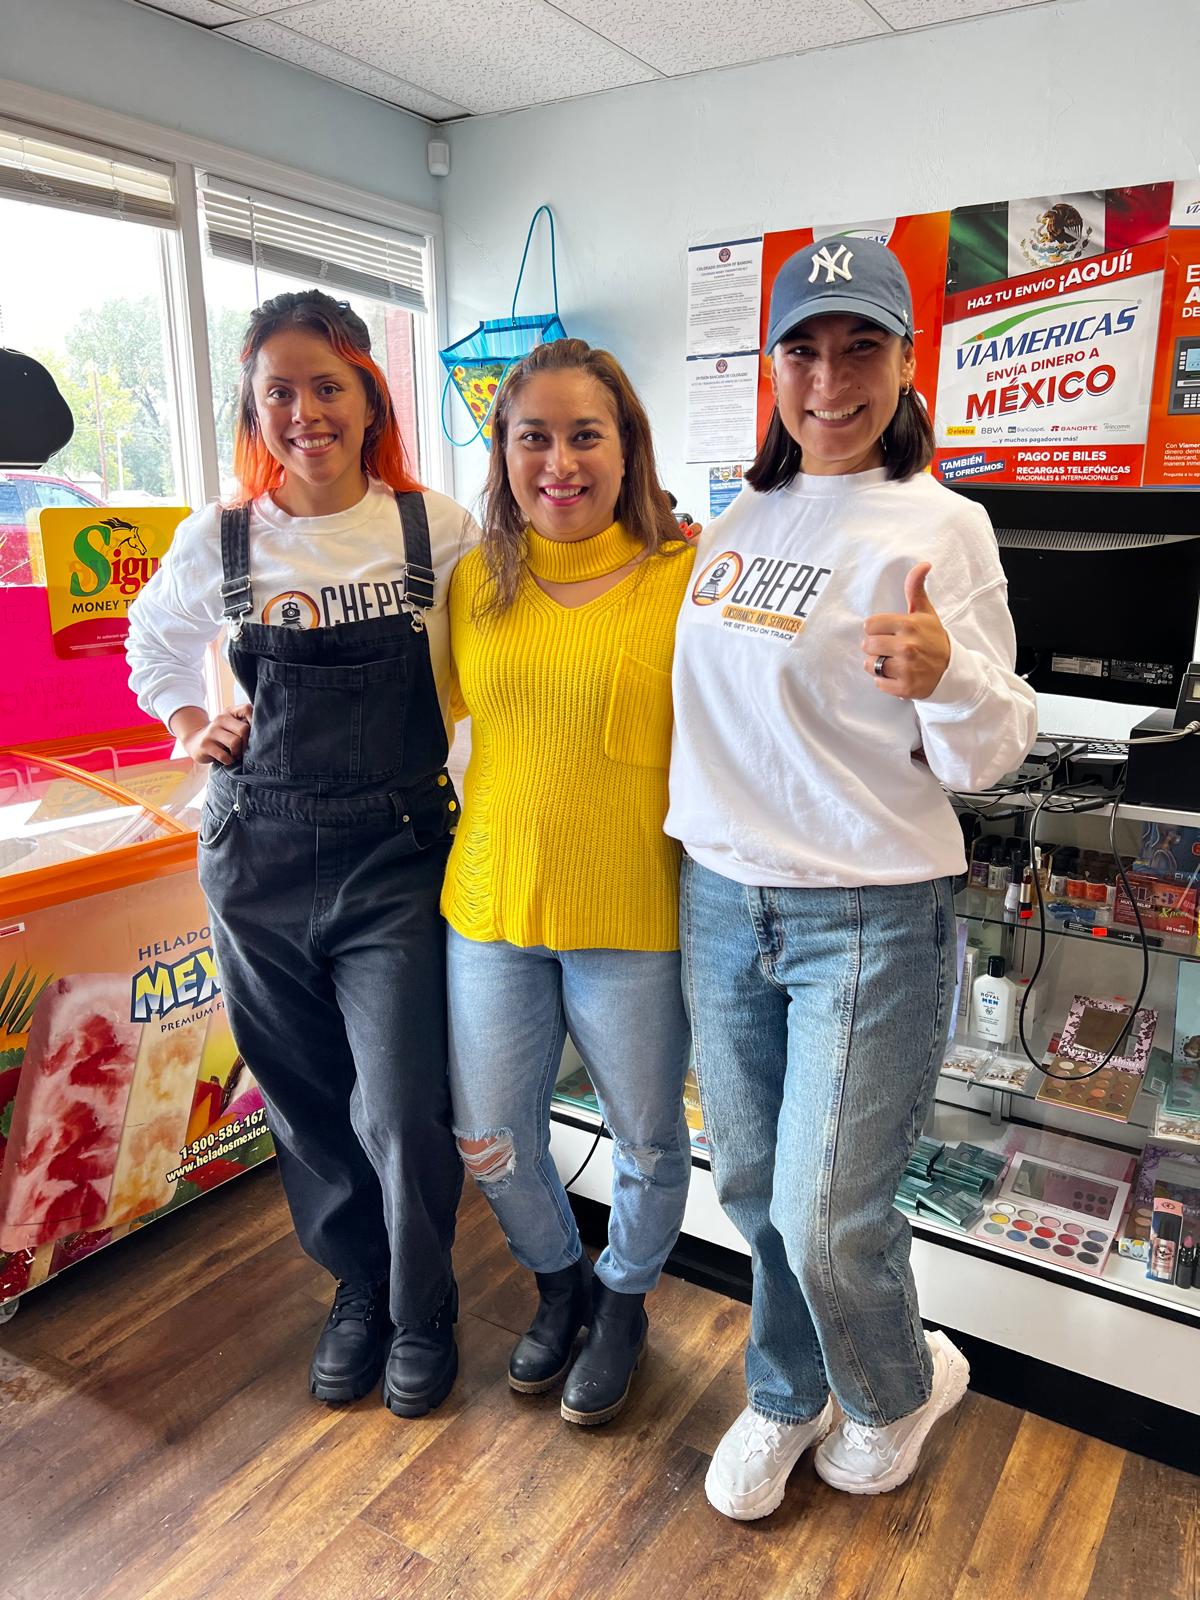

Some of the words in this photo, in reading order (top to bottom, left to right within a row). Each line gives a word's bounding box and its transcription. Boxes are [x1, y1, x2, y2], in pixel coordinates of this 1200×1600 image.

[808, 244, 854, 283] NY
[967, 296, 992, 311] HAZ
[995, 289, 1012, 301] TU
[1015, 278, 1056, 298] ENVÍO
[1058, 249, 1133, 293] ¡AQUÍ!
[957, 305, 1139, 370] VIAMERICAS
[986, 362, 1027, 382] ENVÍA
[1031, 351, 1086, 372] DINERO
[1089, 347, 1100, 359] A
[965, 364, 1117, 423] MÉXICO
[981, 426, 1003, 434] BBVA
[1029, 436, 1062, 444] pagadores
[941, 454, 983, 471] TAMBIÉN
[1017, 451, 1051, 461] PAGO
[1053, 451, 1070, 461] DE
[1072, 450, 1107, 461] BILES
[944, 471, 955, 479] TE
[955, 462, 1004, 477] OFRECEMOS:
[1016, 465, 1065, 475] RECARGAS
[1067, 464, 1131, 474] TELEFÓNICAS
[731, 556, 832, 618] CHEPE
[71, 600, 120, 614] MONEY
[723, 620, 732, 628] WE
[734, 622, 746, 630] GET
[746, 625, 760, 633] YOU
[760, 628, 770, 636] ON
[770, 630, 795, 641] TRACK
[768, 615, 801, 633] SERVICES
[981, 992, 1000, 1000] ROYAL
[981, 997, 999, 1006] MEN
[161, 1007, 213, 1033] PREMIUM
[179, 1107, 268, 1160] 1-800-586-167
